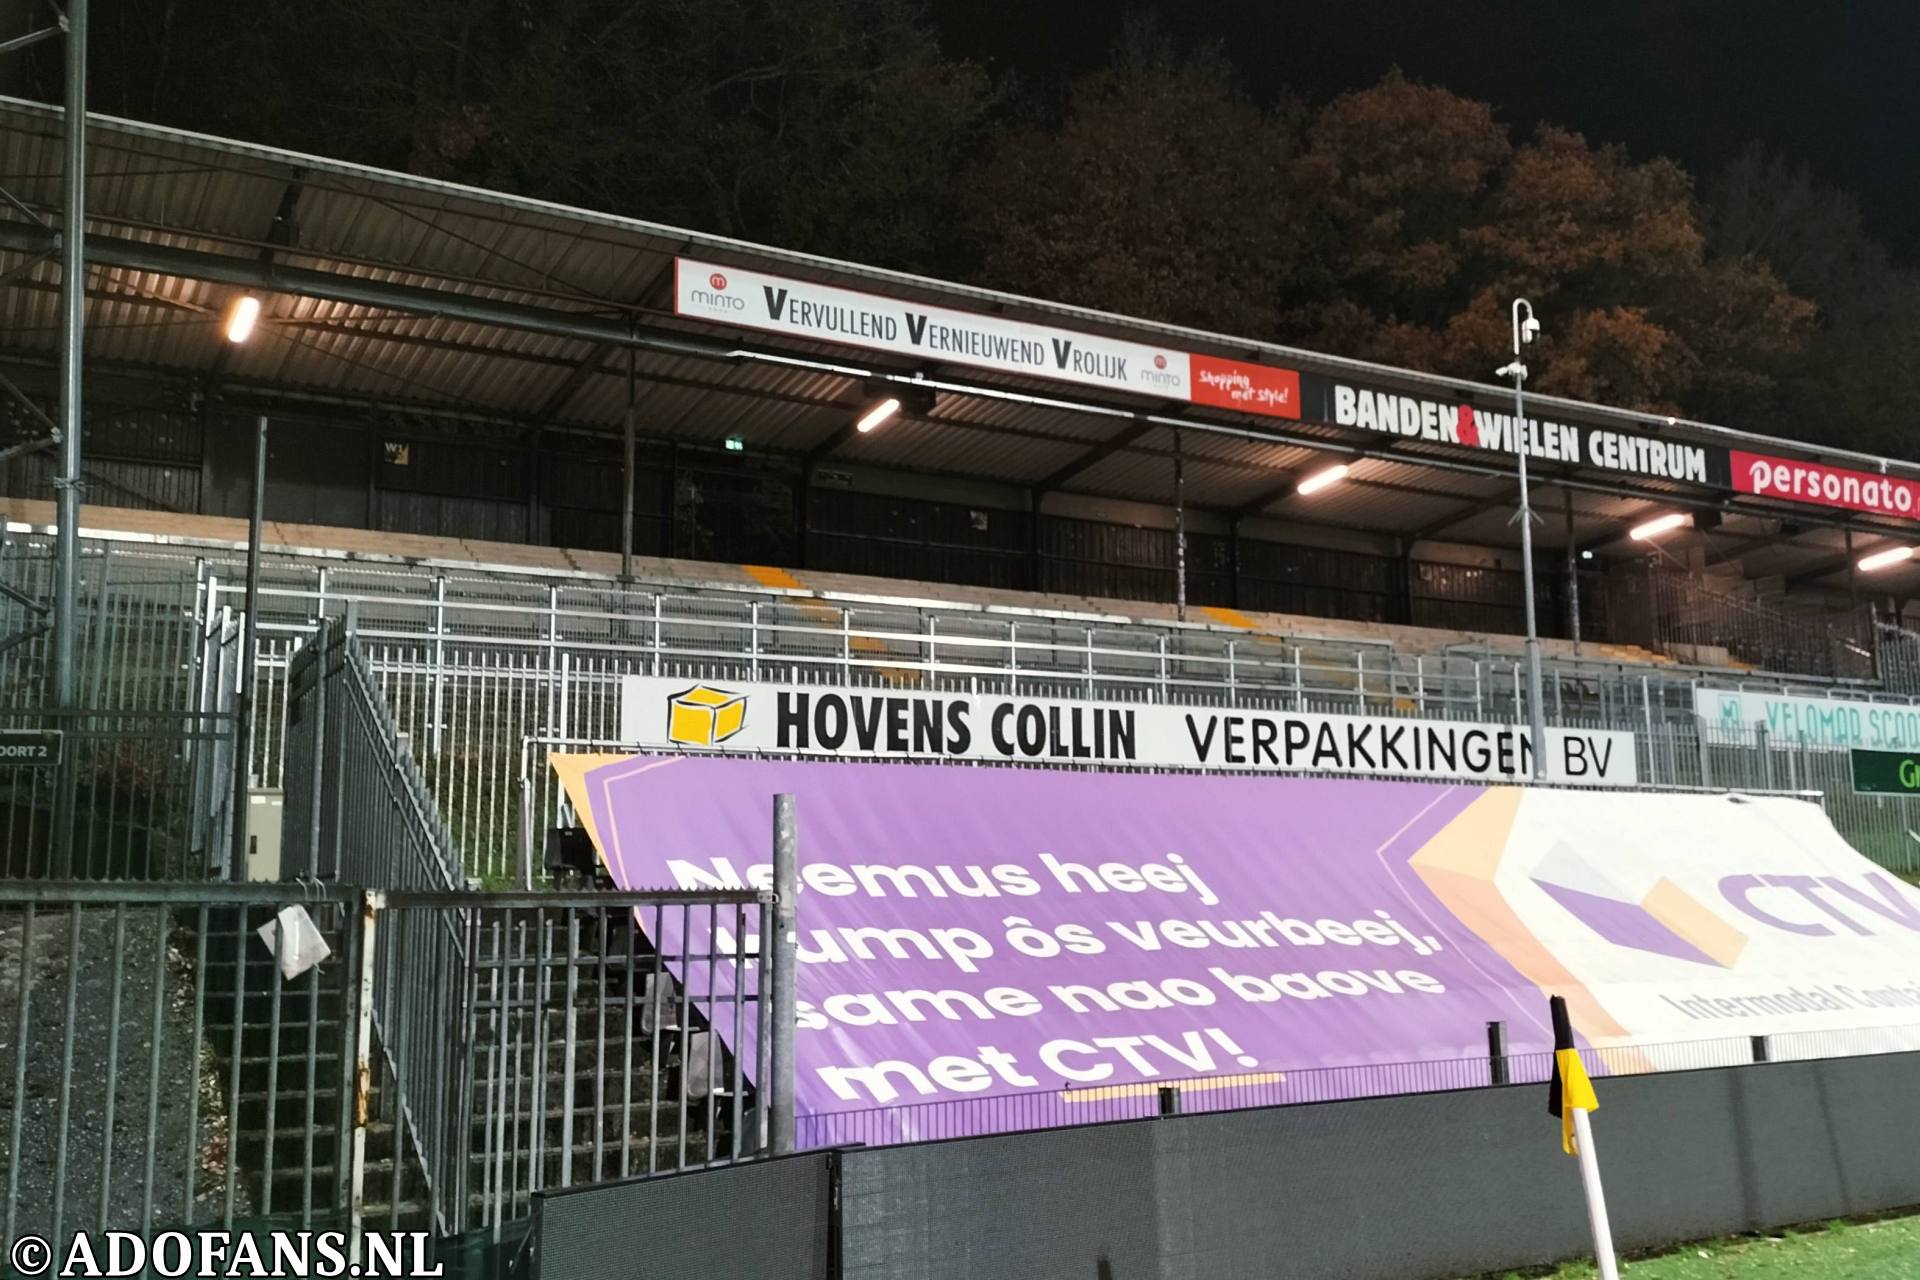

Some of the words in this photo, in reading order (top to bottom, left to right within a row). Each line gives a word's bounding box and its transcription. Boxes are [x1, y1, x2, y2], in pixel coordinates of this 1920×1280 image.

[763, 285, 897, 341] VERVULLEND
[905, 312, 1044, 366] VERNIEUWEND
[1052, 337, 1128, 381] VROLIJK
[1589, 430, 1707, 483] CENTRUM
[1749, 460, 1912, 512] personato
[38, 745, 47, 757] 2
[776, 691, 972, 755] HOVENS
[991, 702, 1136, 760] COLLIN
[1564, 736, 1612, 778] BV
[1038, 853, 1219, 905] heej
[1002, 916, 1107, 958] ôs
[1106, 910, 1443, 956] veurbeej,
[796, 987, 1043, 1030] same
[1048, 977, 1216, 1014] nao
[1208, 967, 1446, 1003] baove
[1658, 984, 1854, 1020] Intermodal
[817, 1046, 1039, 1103] met
[1039, 1028, 1259, 1081] CTV!
